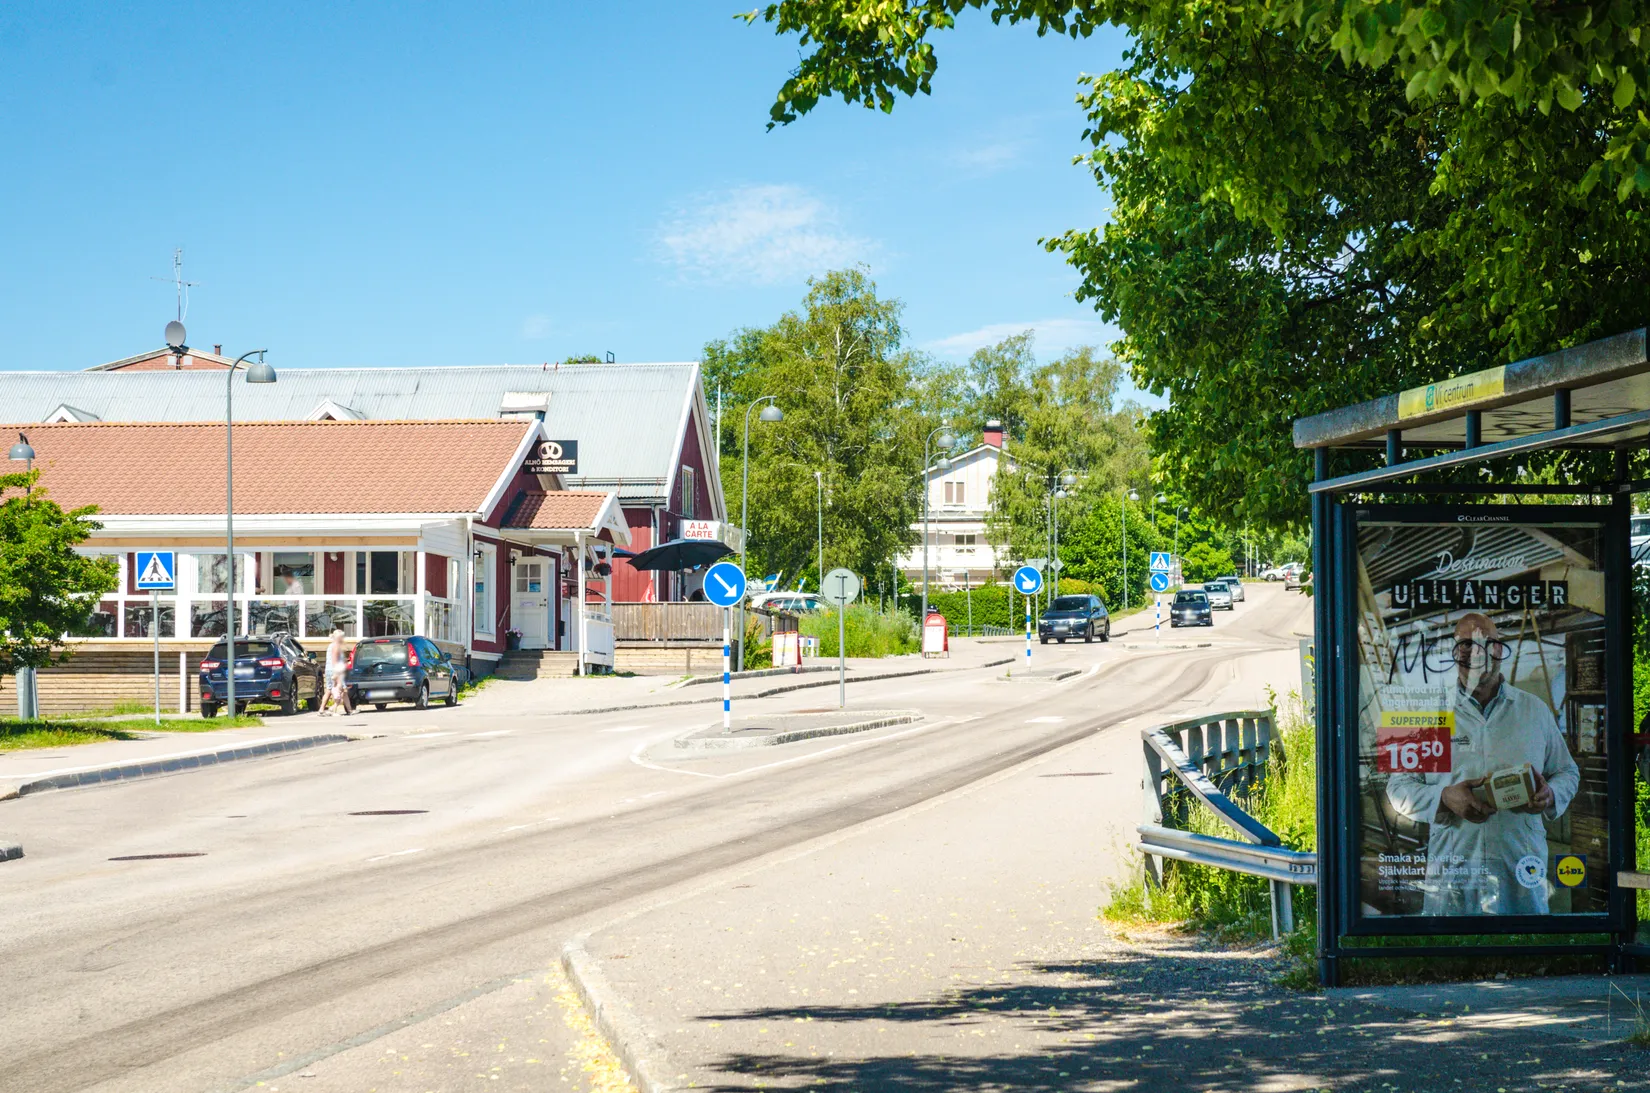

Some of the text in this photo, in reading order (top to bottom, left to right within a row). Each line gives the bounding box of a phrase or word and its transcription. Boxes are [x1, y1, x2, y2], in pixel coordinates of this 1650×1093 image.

[1444, 382, 1474, 403] centrum
[690, 522, 709, 530] A LA
[685, 530, 713, 539] CARTE
[1436, 550, 1525, 573] Destination
[1394, 581, 1566, 605] ULLÅNGER
[1390, 716, 1447, 726] SUPERPRIS!
[1378, 853, 1468, 865] Smaka på Sverige.
[1378, 865, 1425, 877] Självklart
[1442, 865, 1469, 875] bästa
[1470, 865, 1492, 878] pris.
